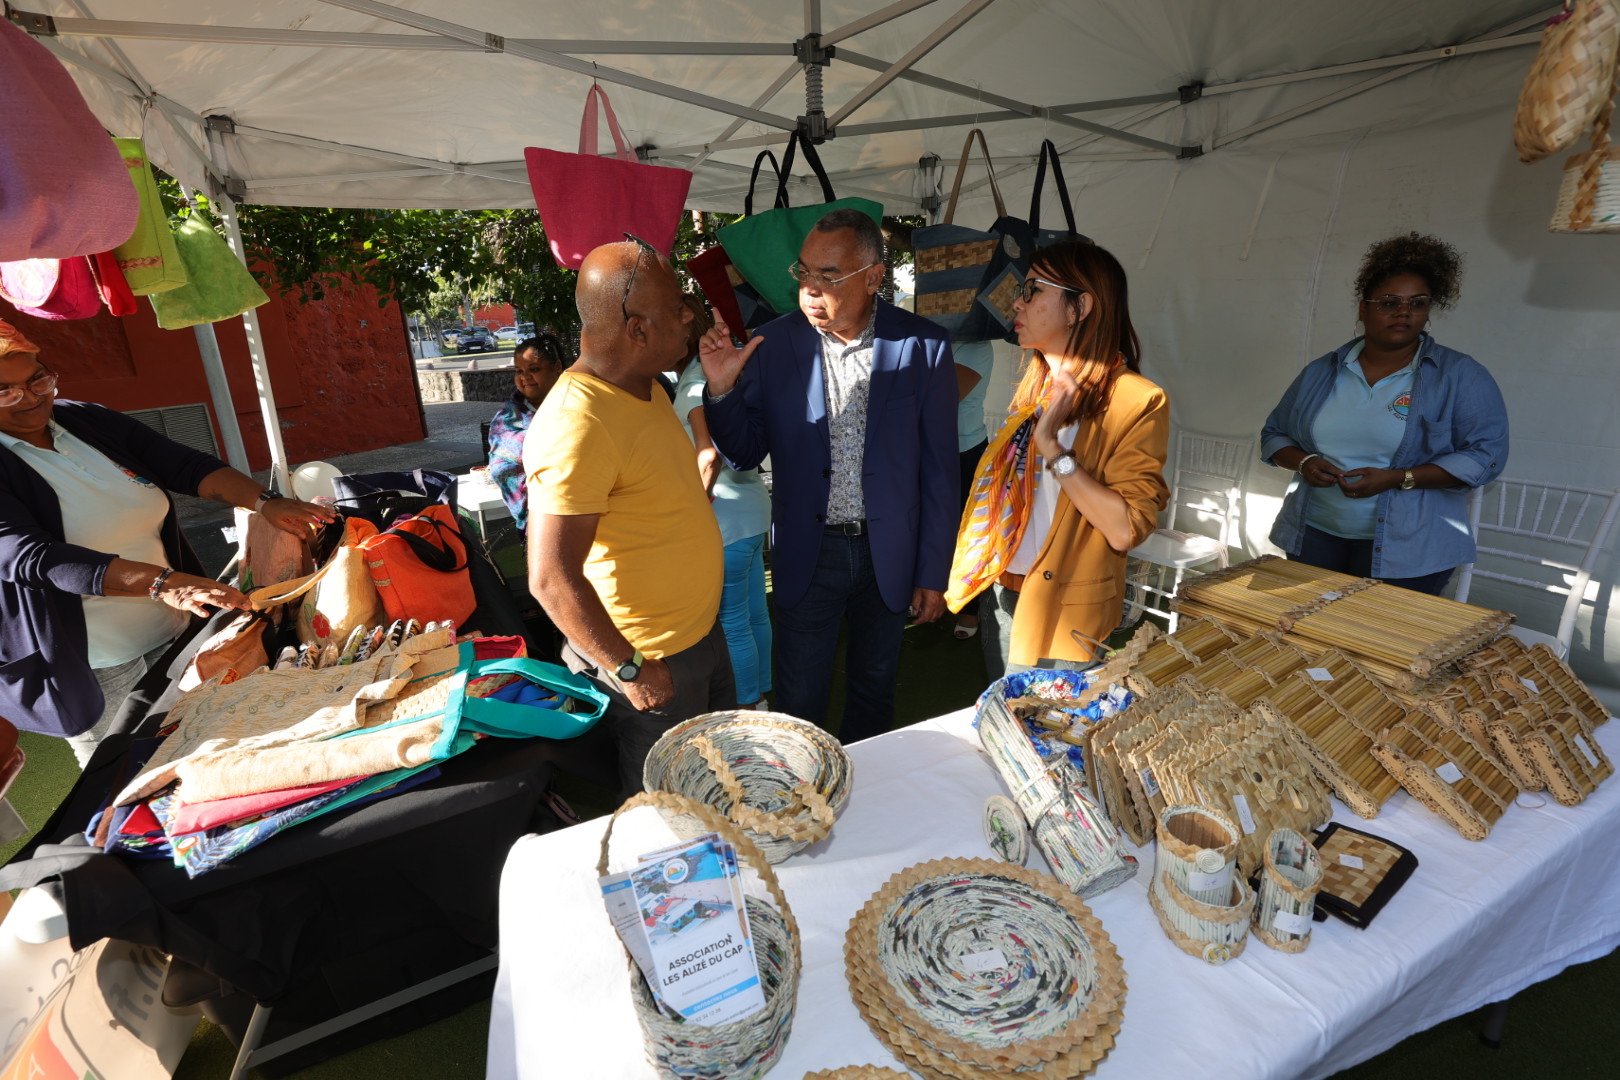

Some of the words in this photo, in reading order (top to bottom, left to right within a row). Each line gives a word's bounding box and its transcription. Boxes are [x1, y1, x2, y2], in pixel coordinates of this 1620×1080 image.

[663, 973, 680, 987] LES
[682, 959, 708, 978] ALIZÉ
[708, 954, 723, 966] DU
[724, 944, 743, 959] CAP
[669, 935, 732, 971] ASSOCIATION
